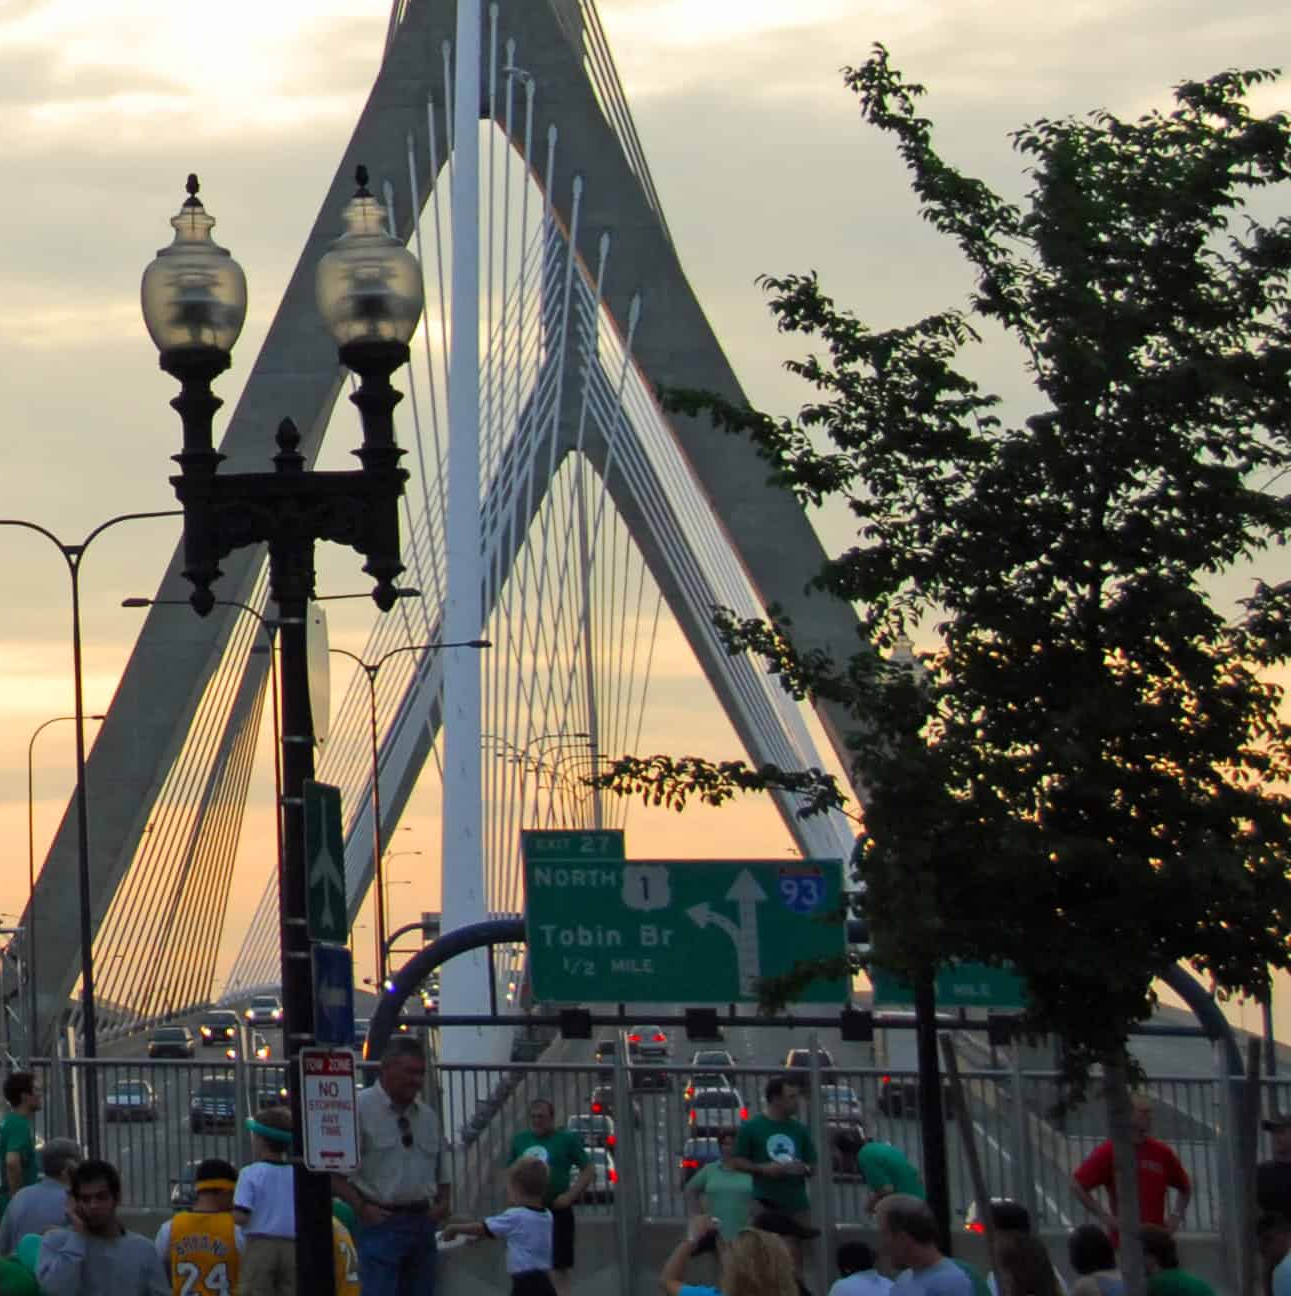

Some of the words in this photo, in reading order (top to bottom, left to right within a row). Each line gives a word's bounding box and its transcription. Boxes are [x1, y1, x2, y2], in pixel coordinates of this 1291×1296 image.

[580, 835, 610, 854] 27
[534, 866, 617, 888] NORTH
[640, 876, 650, 901] 1
[779, 878, 821, 904] 93
[539, 923, 623, 948] Tobin
[639, 923, 674, 948] Br
[562, 957, 596, 977] 1/2
[610, 957, 655, 974] MILE
[305, 1057, 324, 1072] TOW
[329, 1056, 353, 1072] ZONE
[318, 1080, 339, 1098] NO
[176, 1262, 230, 1296] 24
